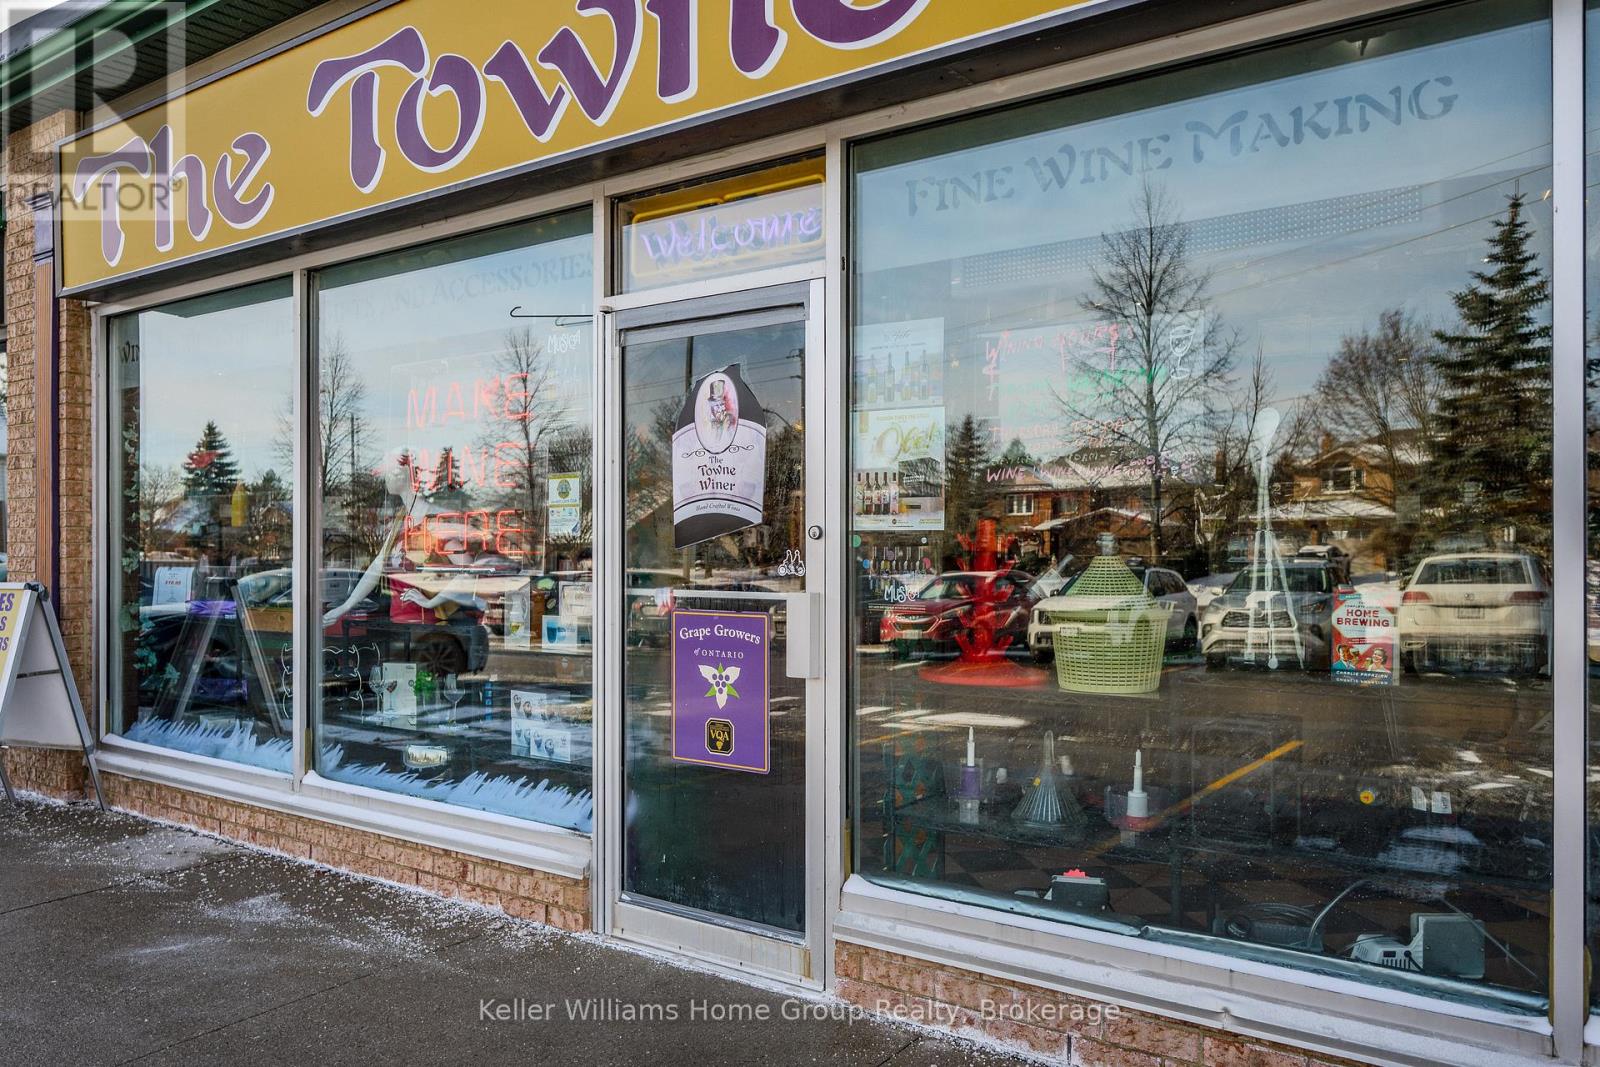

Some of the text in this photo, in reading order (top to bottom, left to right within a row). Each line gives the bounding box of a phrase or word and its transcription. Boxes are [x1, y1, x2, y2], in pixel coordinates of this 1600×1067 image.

[905, 75, 1459, 217] FINE WINE MAKING
[73, 124, 275, 268] The
[407, 372, 532, 430] MAKE
[708, 455, 724, 464] The
[407, 441, 532, 493] WINE
[697, 464, 736, 477] Towne
[699, 477, 736, 491] Winer
[1346, 608, 1380, 618] HOME
[1336, 617, 1390, 628] BREWING
[679, 624, 761, 645] Grape Growers
[701, 649, 744, 660] ONTARIO
[710, 729, 729, 743] VQA
